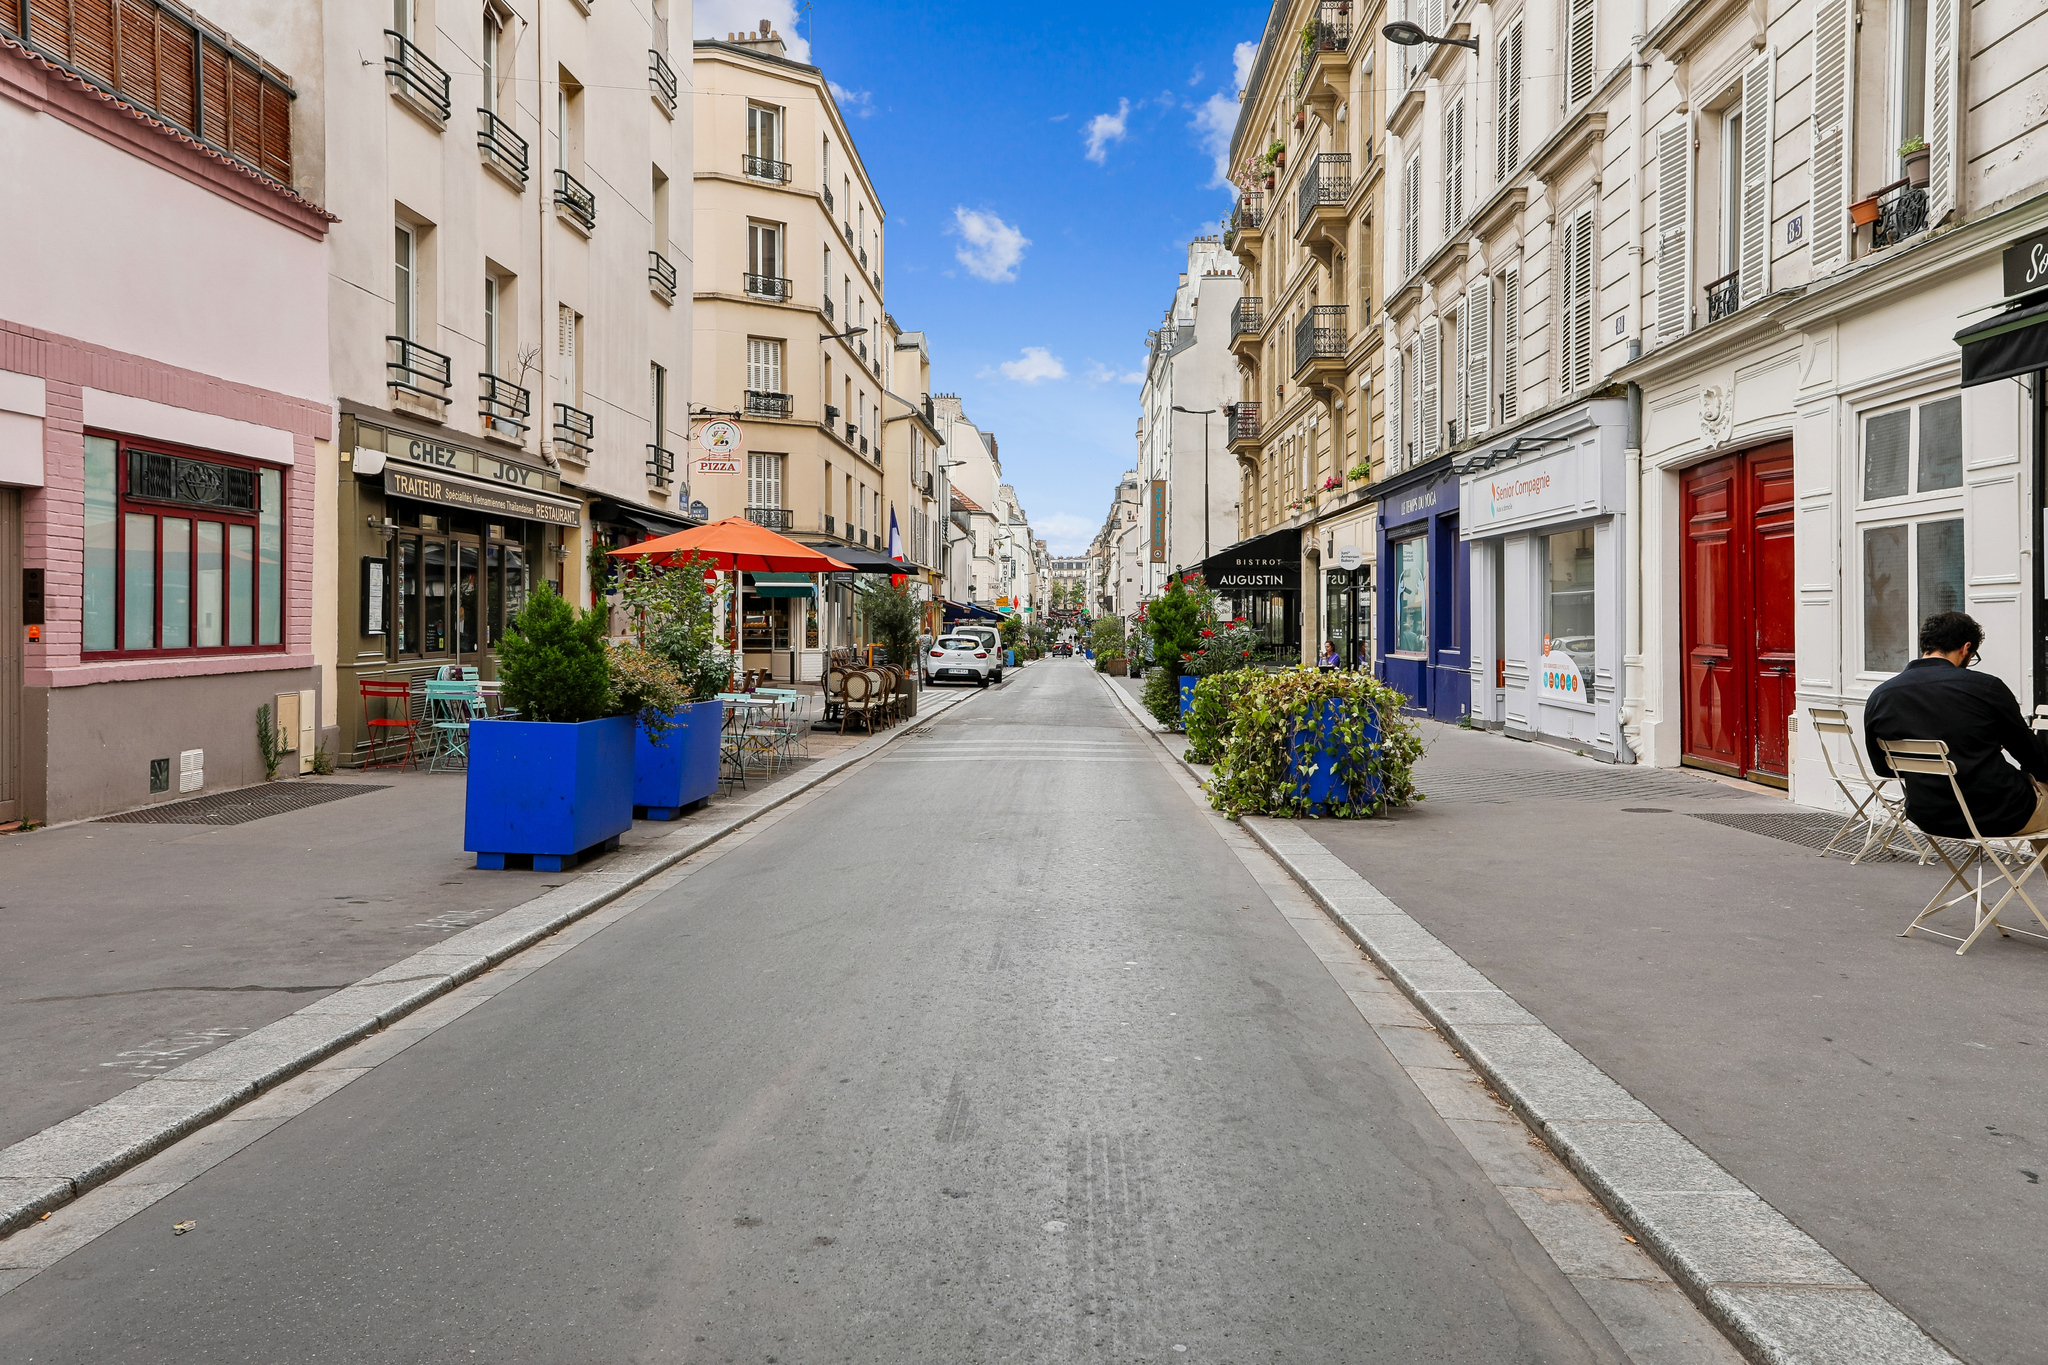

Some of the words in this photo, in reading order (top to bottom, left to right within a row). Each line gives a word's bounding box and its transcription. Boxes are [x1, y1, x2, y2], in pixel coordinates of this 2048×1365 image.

[1789, 217, 1802, 241] 83
[409, 440, 457, 468] CHEZ
[493, 463, 531, 485] JOY
[700, 462, 736, 471] PIZZA
[394, 474, 442, 500] TRAITEUR
[473, 494, 506, 509] Vietnamiennes
[507, 501, 534, 515] Thaïlandaises
[1496, 482, 1514, 501] Senior
[1515, 471, 1550, 497] Compagnie
[1424, 490, 1436, 508] YOGA
[1219, 575, 1283, 585] AUGUSTIN
